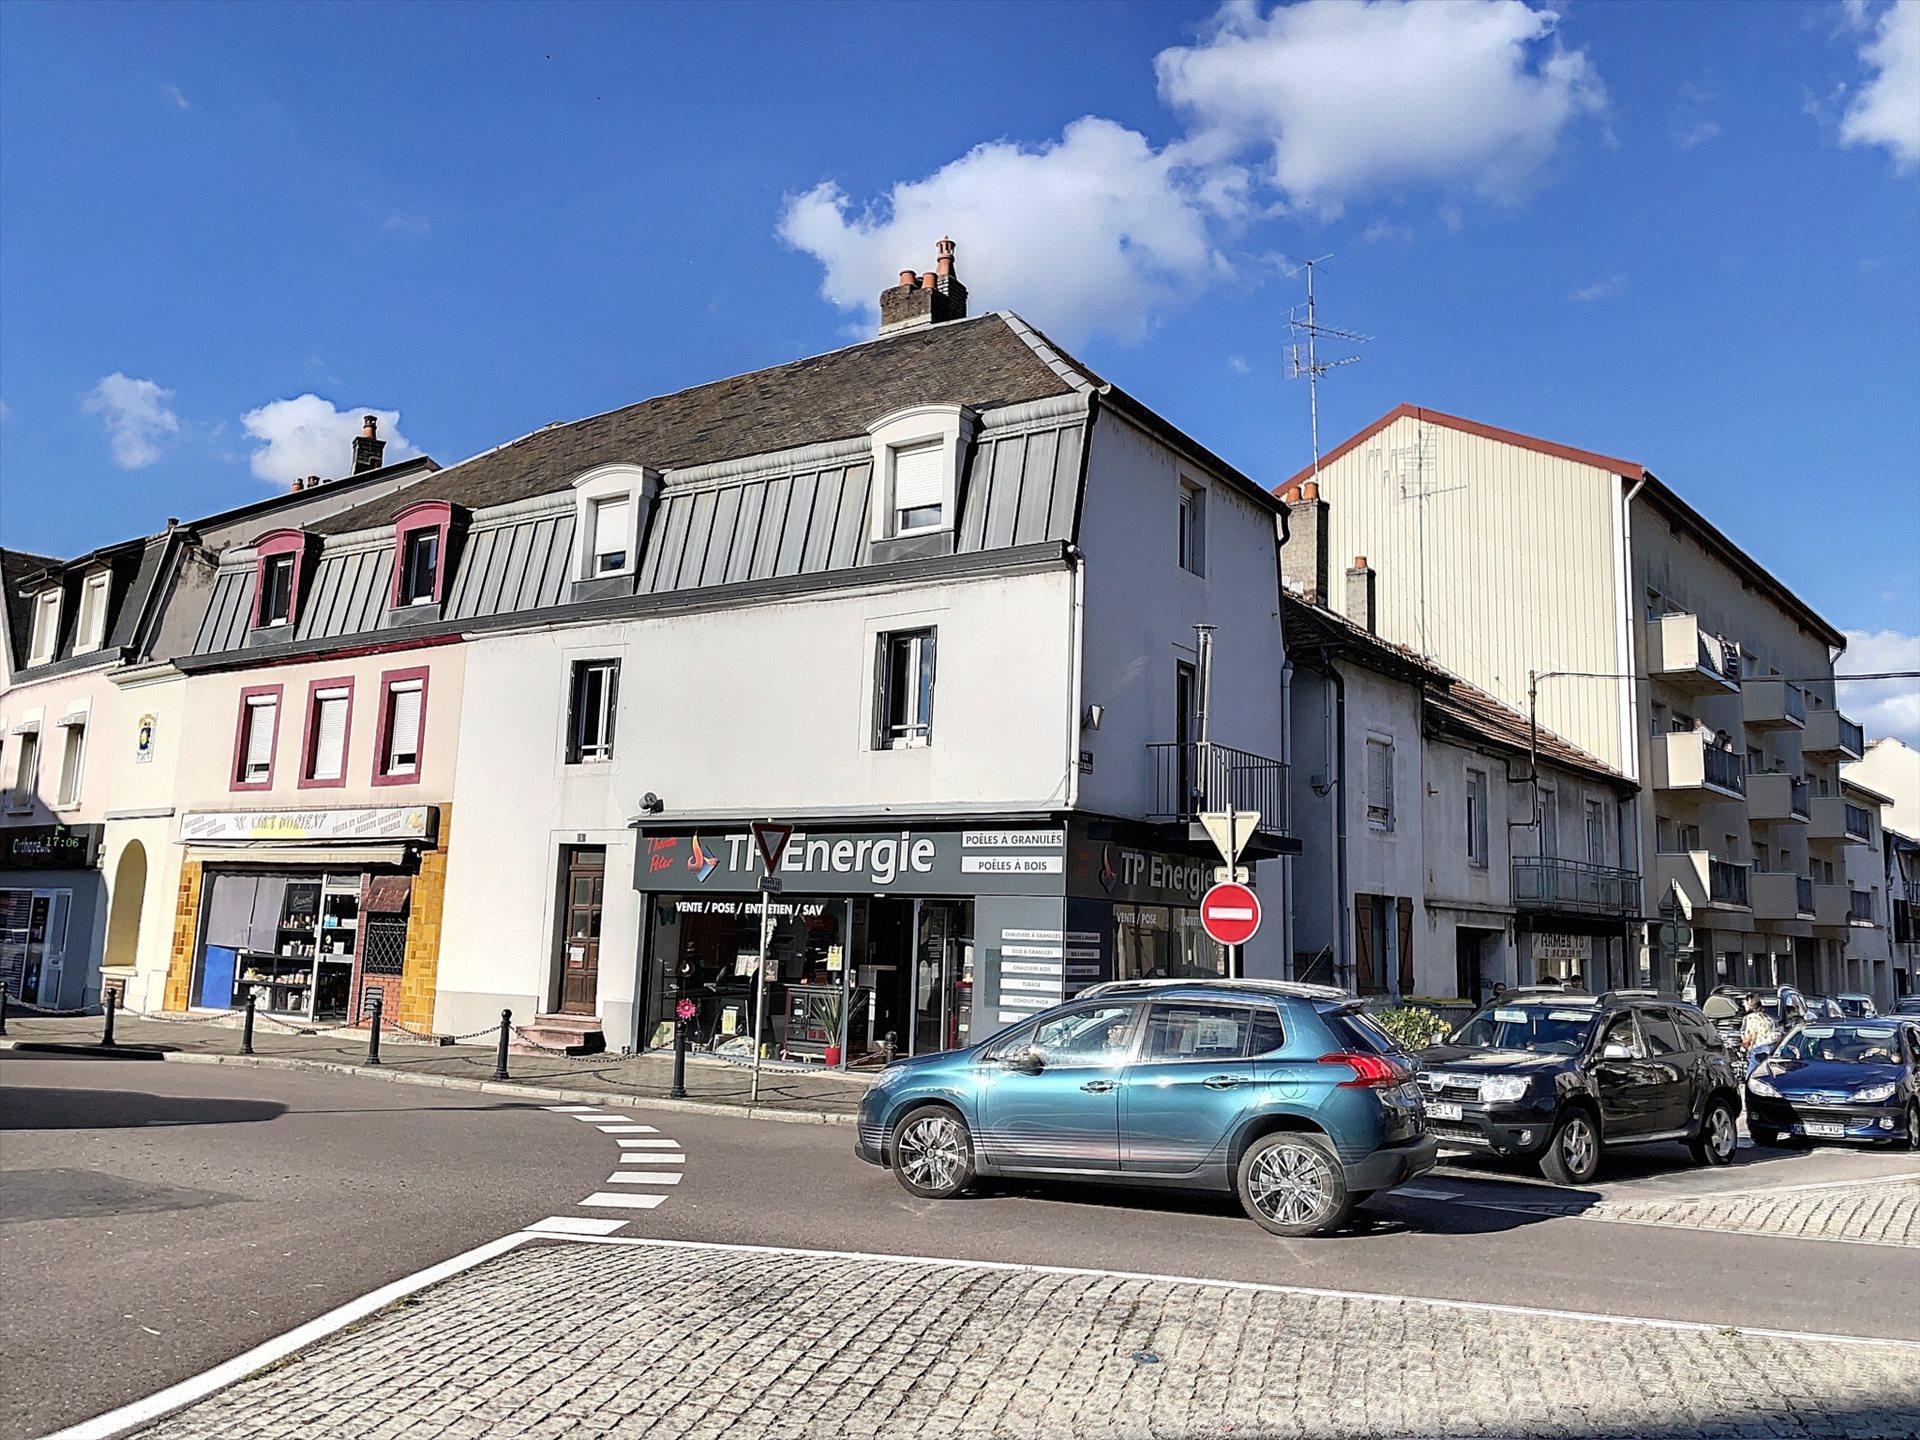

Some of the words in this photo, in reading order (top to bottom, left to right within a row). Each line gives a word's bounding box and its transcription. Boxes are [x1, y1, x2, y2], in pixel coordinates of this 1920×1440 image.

[45, 836, 79, 848] 17:06
[965, 832, 998, 845] POÊLES
[1011, 832, 1062, 845] GRANULÉS
[780, 831, 936, 884] Energie
[978, 858, 1011, 871] POÊLES
[1024, 861, 1047, 871] BOIS
[1121, 852, 1146, 886] TP
[1150, 855, 1214, 901] Energie
[675, 901, 703, 913] VENTE
[711, 902, 735, 914] POSE
[745, 903, 793, 915] ENTETIEN
[802, 904, 824, 916] SAV
[1116, 912, 1136, 924] VENTE
[1141, 913, 1157, 925] POSE
